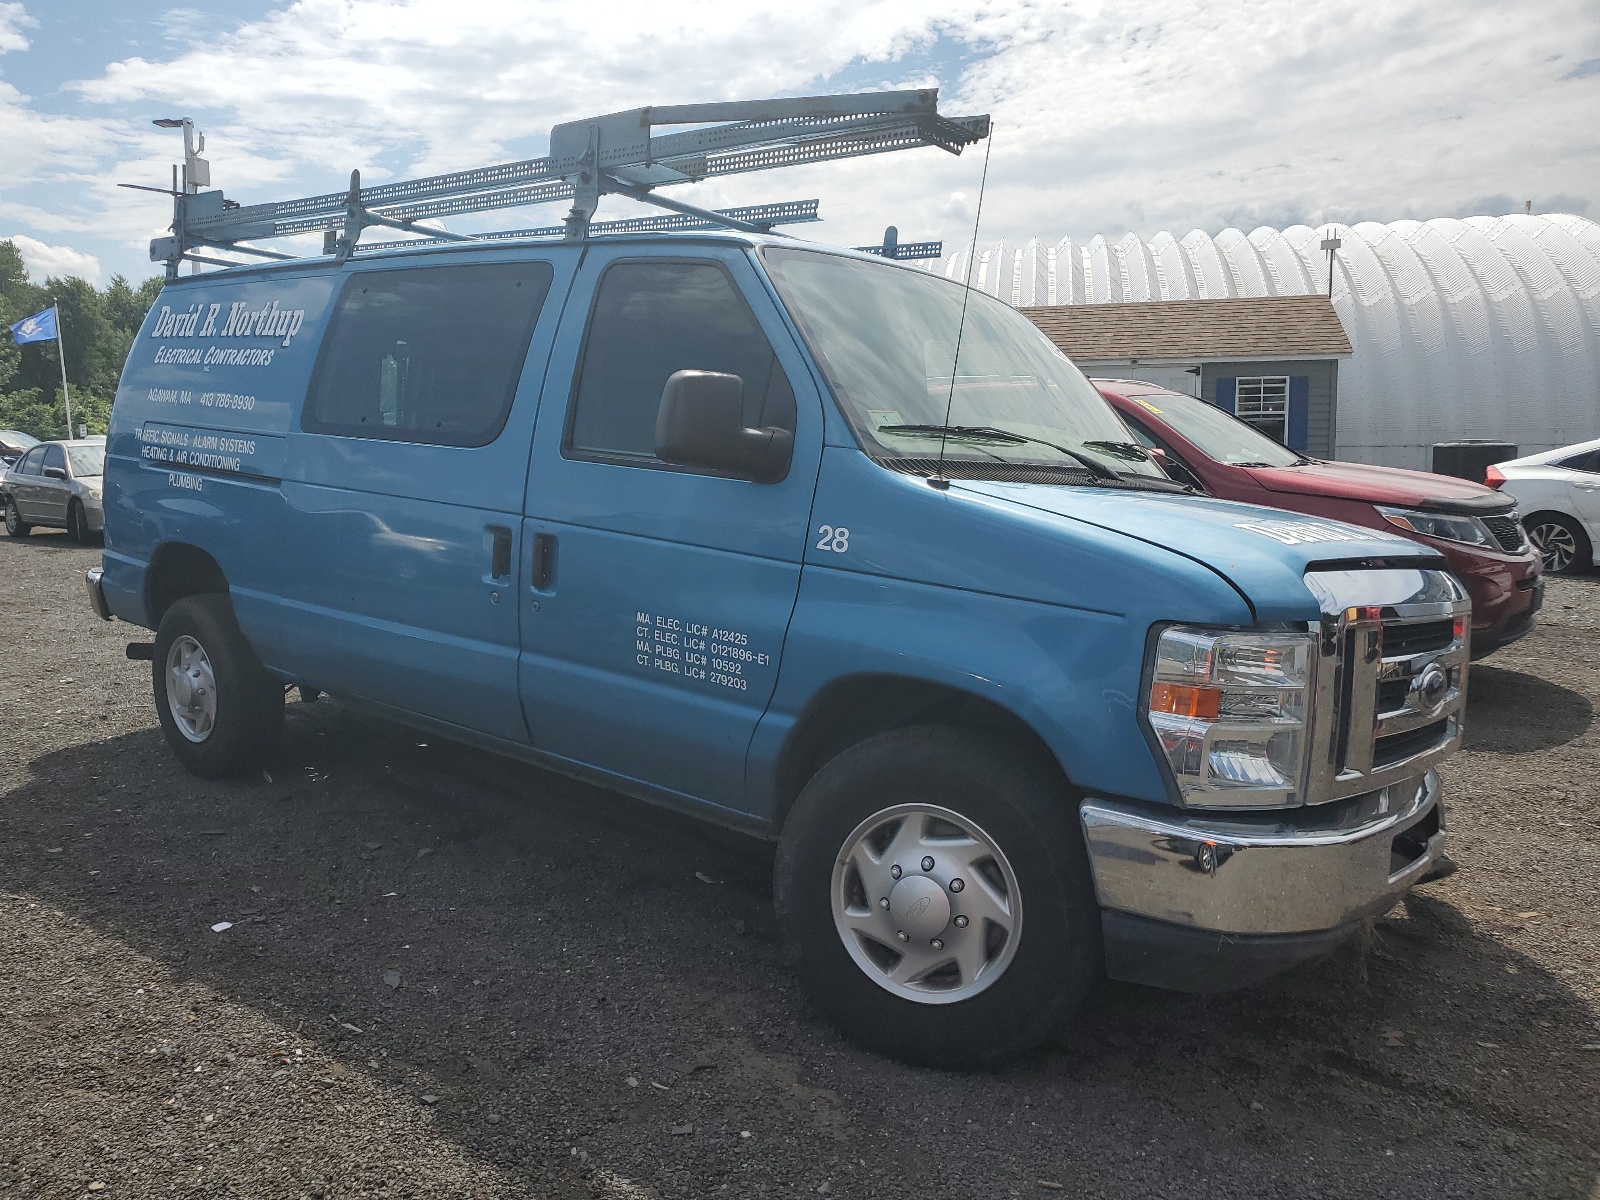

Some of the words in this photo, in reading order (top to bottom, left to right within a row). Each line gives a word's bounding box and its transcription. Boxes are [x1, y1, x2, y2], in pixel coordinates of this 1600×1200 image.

[151, 303, 204, 338] David
[199, 303, 221, 337] R.
[220, 301, 304, 347] Northup
[154, 345, 204, 364] ELECTRICAL
[203, 345, 275, 366] CONTRACTORS
[147, 388, 178, 406] AGAWAM,
[180, 390, 192, 404] MA
[200, 392, 213, 407] 413
[215, 393, 255, 410] 786-8930
[134, 428, 160, 442] TRAFFIC
[160, 430, 189, 447] SIGNALS
[192, 435, 217, 450] ALARM
[219, 437, 256, 455] SYSTEMS
[141, 445, 168, 461] HEATING
[168, 449, 174, 462] &
[176, 450, 188, 463] AIR
[189, 451, 240, 471] CONDITIONING
[168, 473, 203, 491] PLUMBING
[816, 524, 850, 553] 28
[636, 611, 653, 625] MA.
[656, 615, 682, 631] ELEC.
[686, 622, 708, 636] LIC#
[711, 628, 748, 645] A12425
[636, 626, 651, 639] CT.
[654, 629, 680, 645] ELEC.
[684, 636, 706, 651] LIC#
[711, 642, 770, 666] 0121896-E1
[636, 639, 652, 653] MA.
[655, 644, 681, 660] PLBG.
[685, 651, 707, 666] LIC#
[711, 657, 742, 675] 10592
[636, 653, 651, 667] CT.
[654, 657, 680, 674] PLBG.
[684, 665, 706, 680] LIC#
[710, 671, 747, 691] 279203
